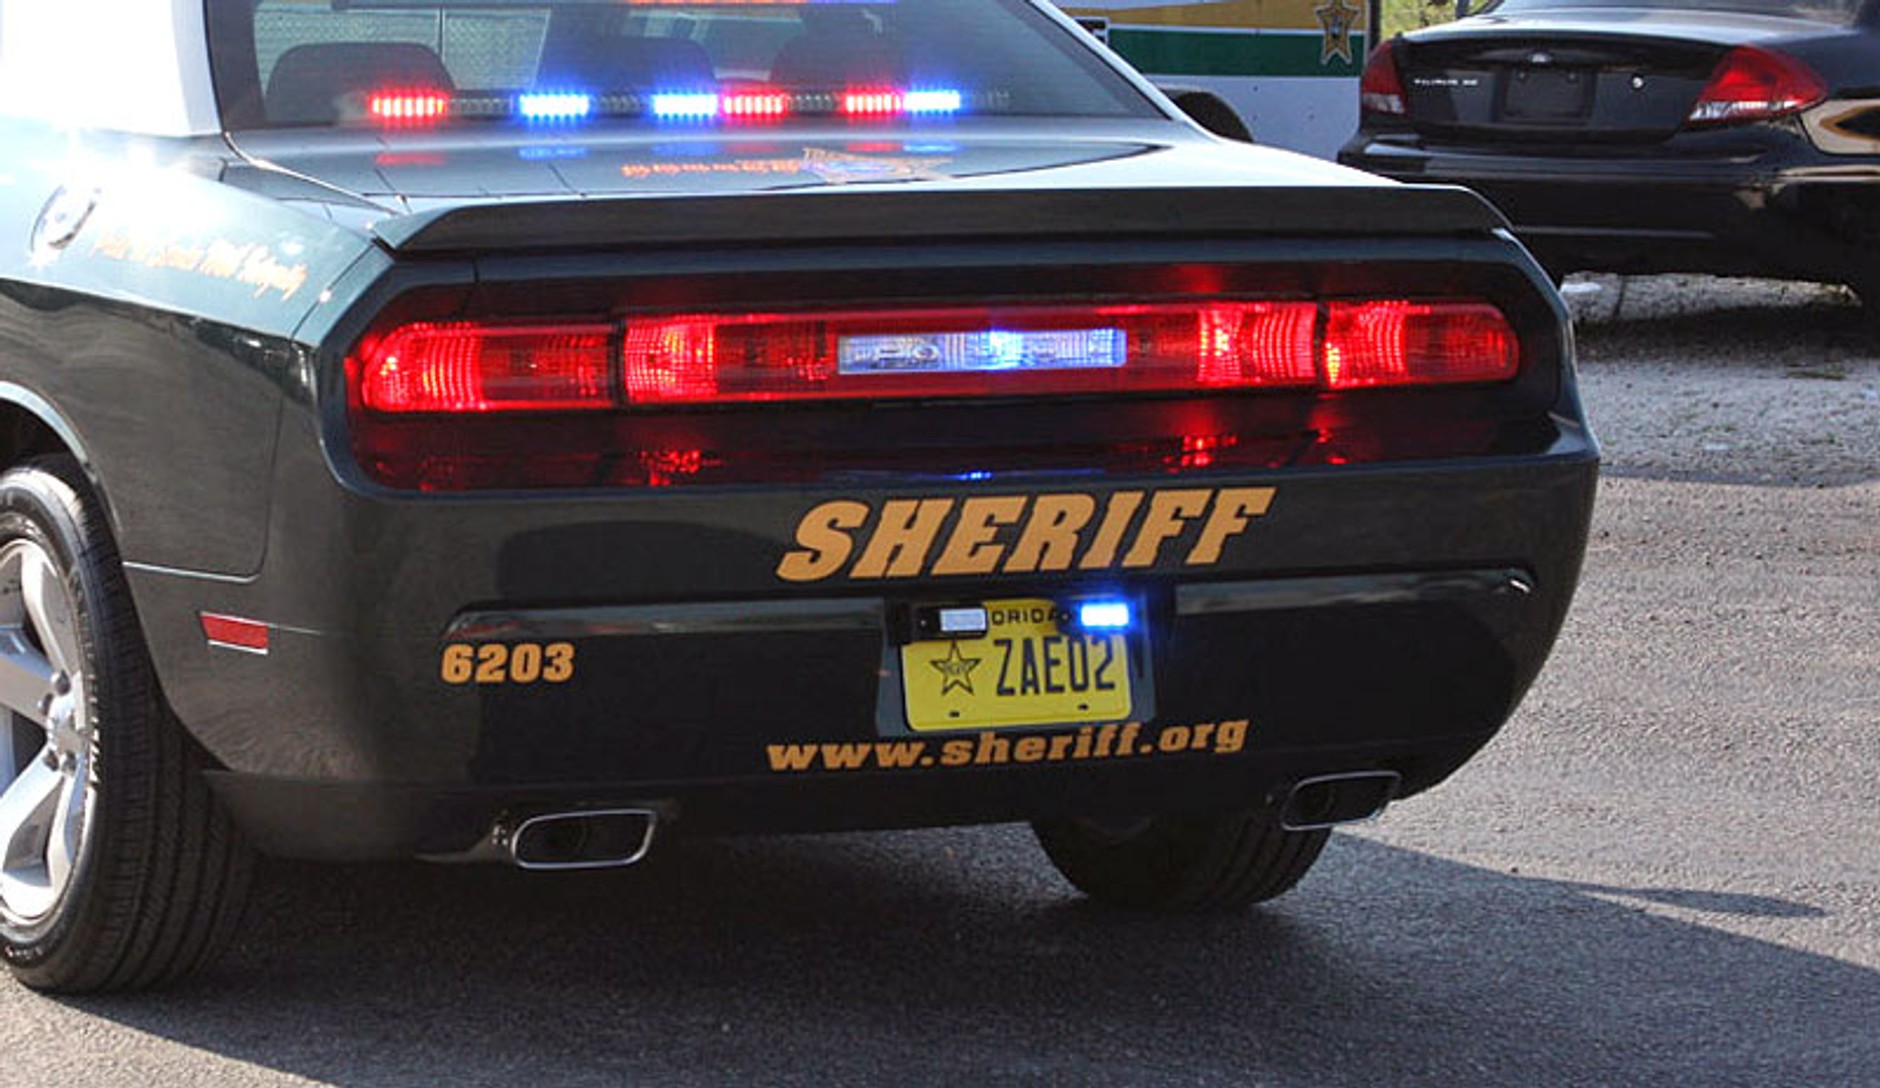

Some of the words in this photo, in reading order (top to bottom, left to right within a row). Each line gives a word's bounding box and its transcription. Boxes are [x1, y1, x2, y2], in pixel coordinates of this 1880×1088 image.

[776, 486, 1277, 582] SHERIFF
[441, 642, 575, 683] 6203
[993, 633, 1116, 697] ZAE02
[766, 718, 1250, 772] www.sheriff.org
